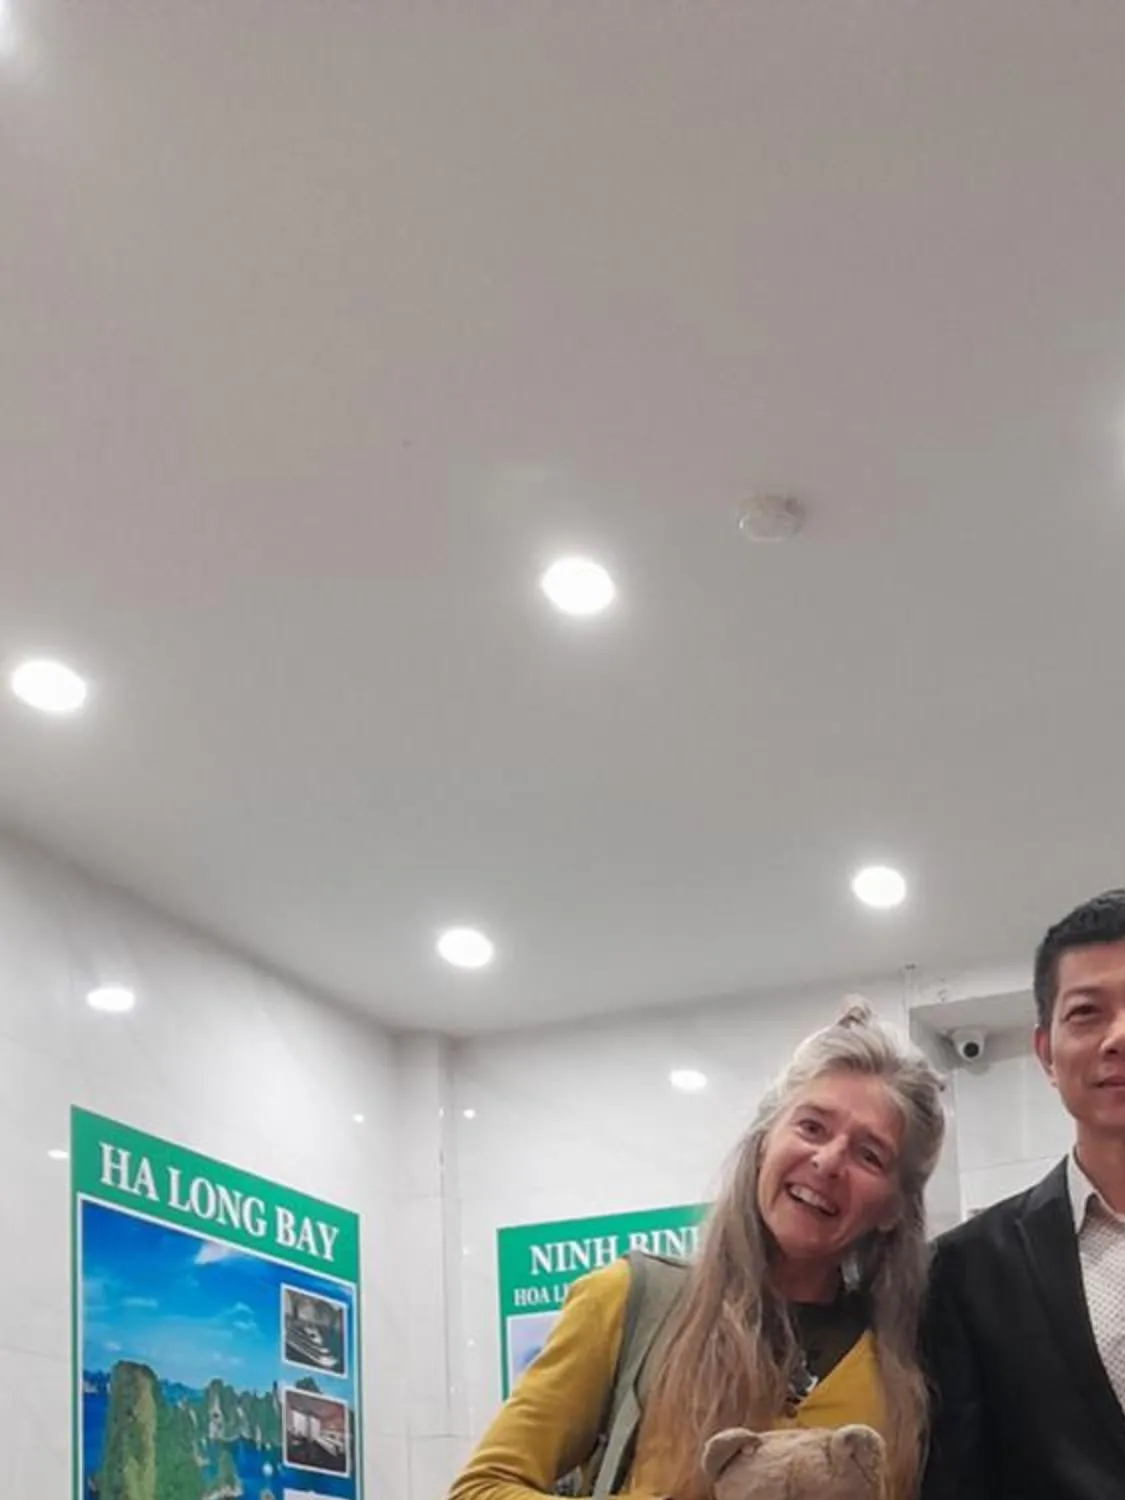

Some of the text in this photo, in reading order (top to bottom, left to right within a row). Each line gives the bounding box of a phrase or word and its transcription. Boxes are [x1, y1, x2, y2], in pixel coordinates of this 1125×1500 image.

[98, 1140, 340, 1262] HA LONG BAY
[529, 1235, 619, 1276] NINH
[513, 1286, 551, 1307] HOA
